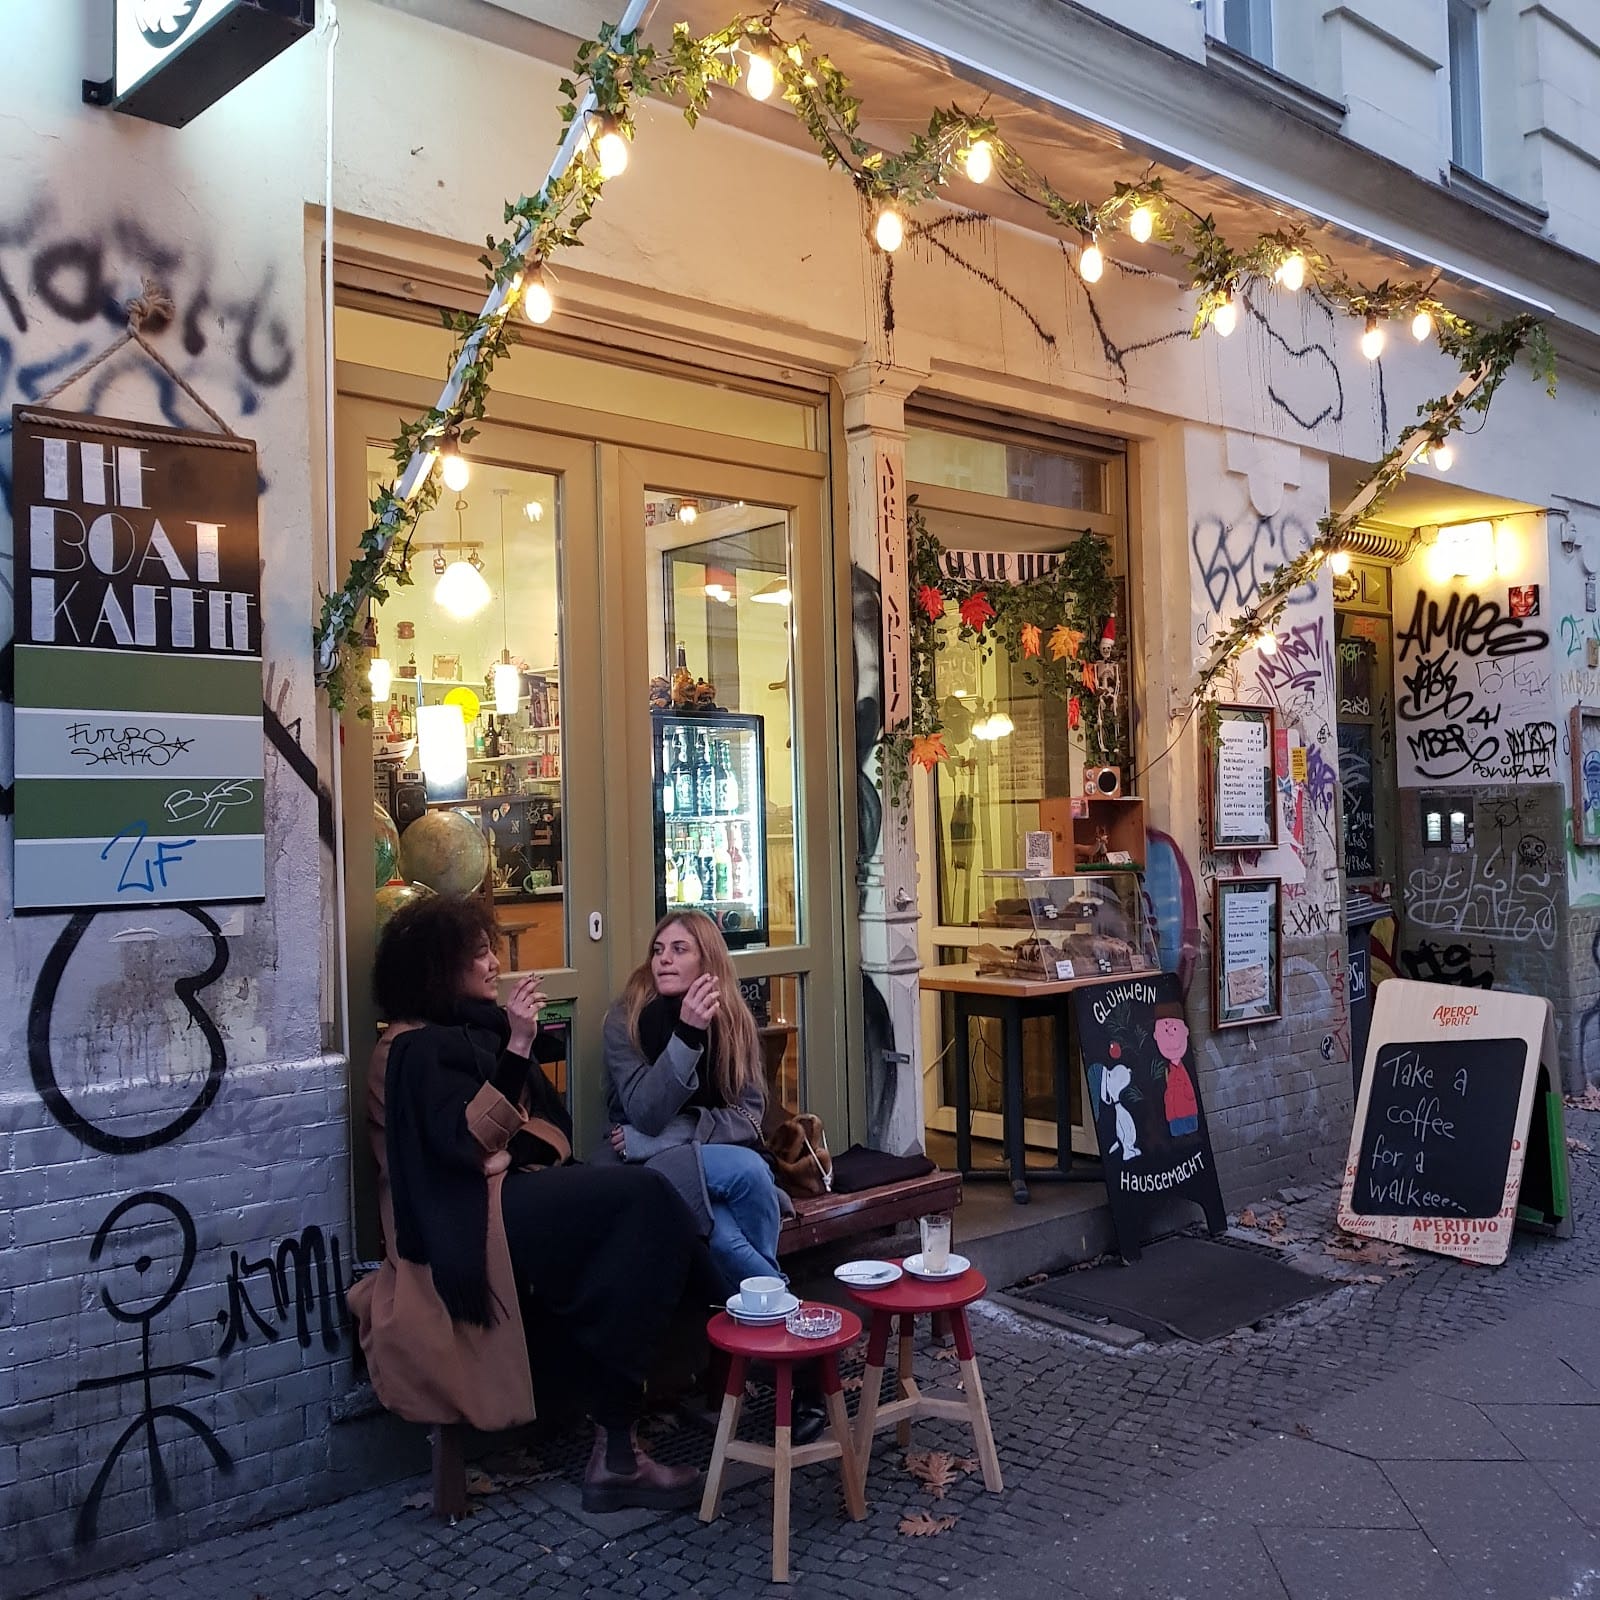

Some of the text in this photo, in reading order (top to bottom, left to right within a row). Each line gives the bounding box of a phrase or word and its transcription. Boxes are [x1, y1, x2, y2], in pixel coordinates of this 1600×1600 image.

[31, 436, 156, 509] THE
[30, 505, 227, 583] BOAT
[31, 576, 256, 651] KAFFEE
[1433, 1005, 1478, 1019] APEROL
[1440, 1017, 1470, 1026] SPRITZ
[1383, 1051, 1467, 1096] Take a
[1387, 1097, 1455, 1142] coffee
[1372, 1134, 1424, 1173] for a
[1413, 1219, 1498, 1233] APERITIVO
